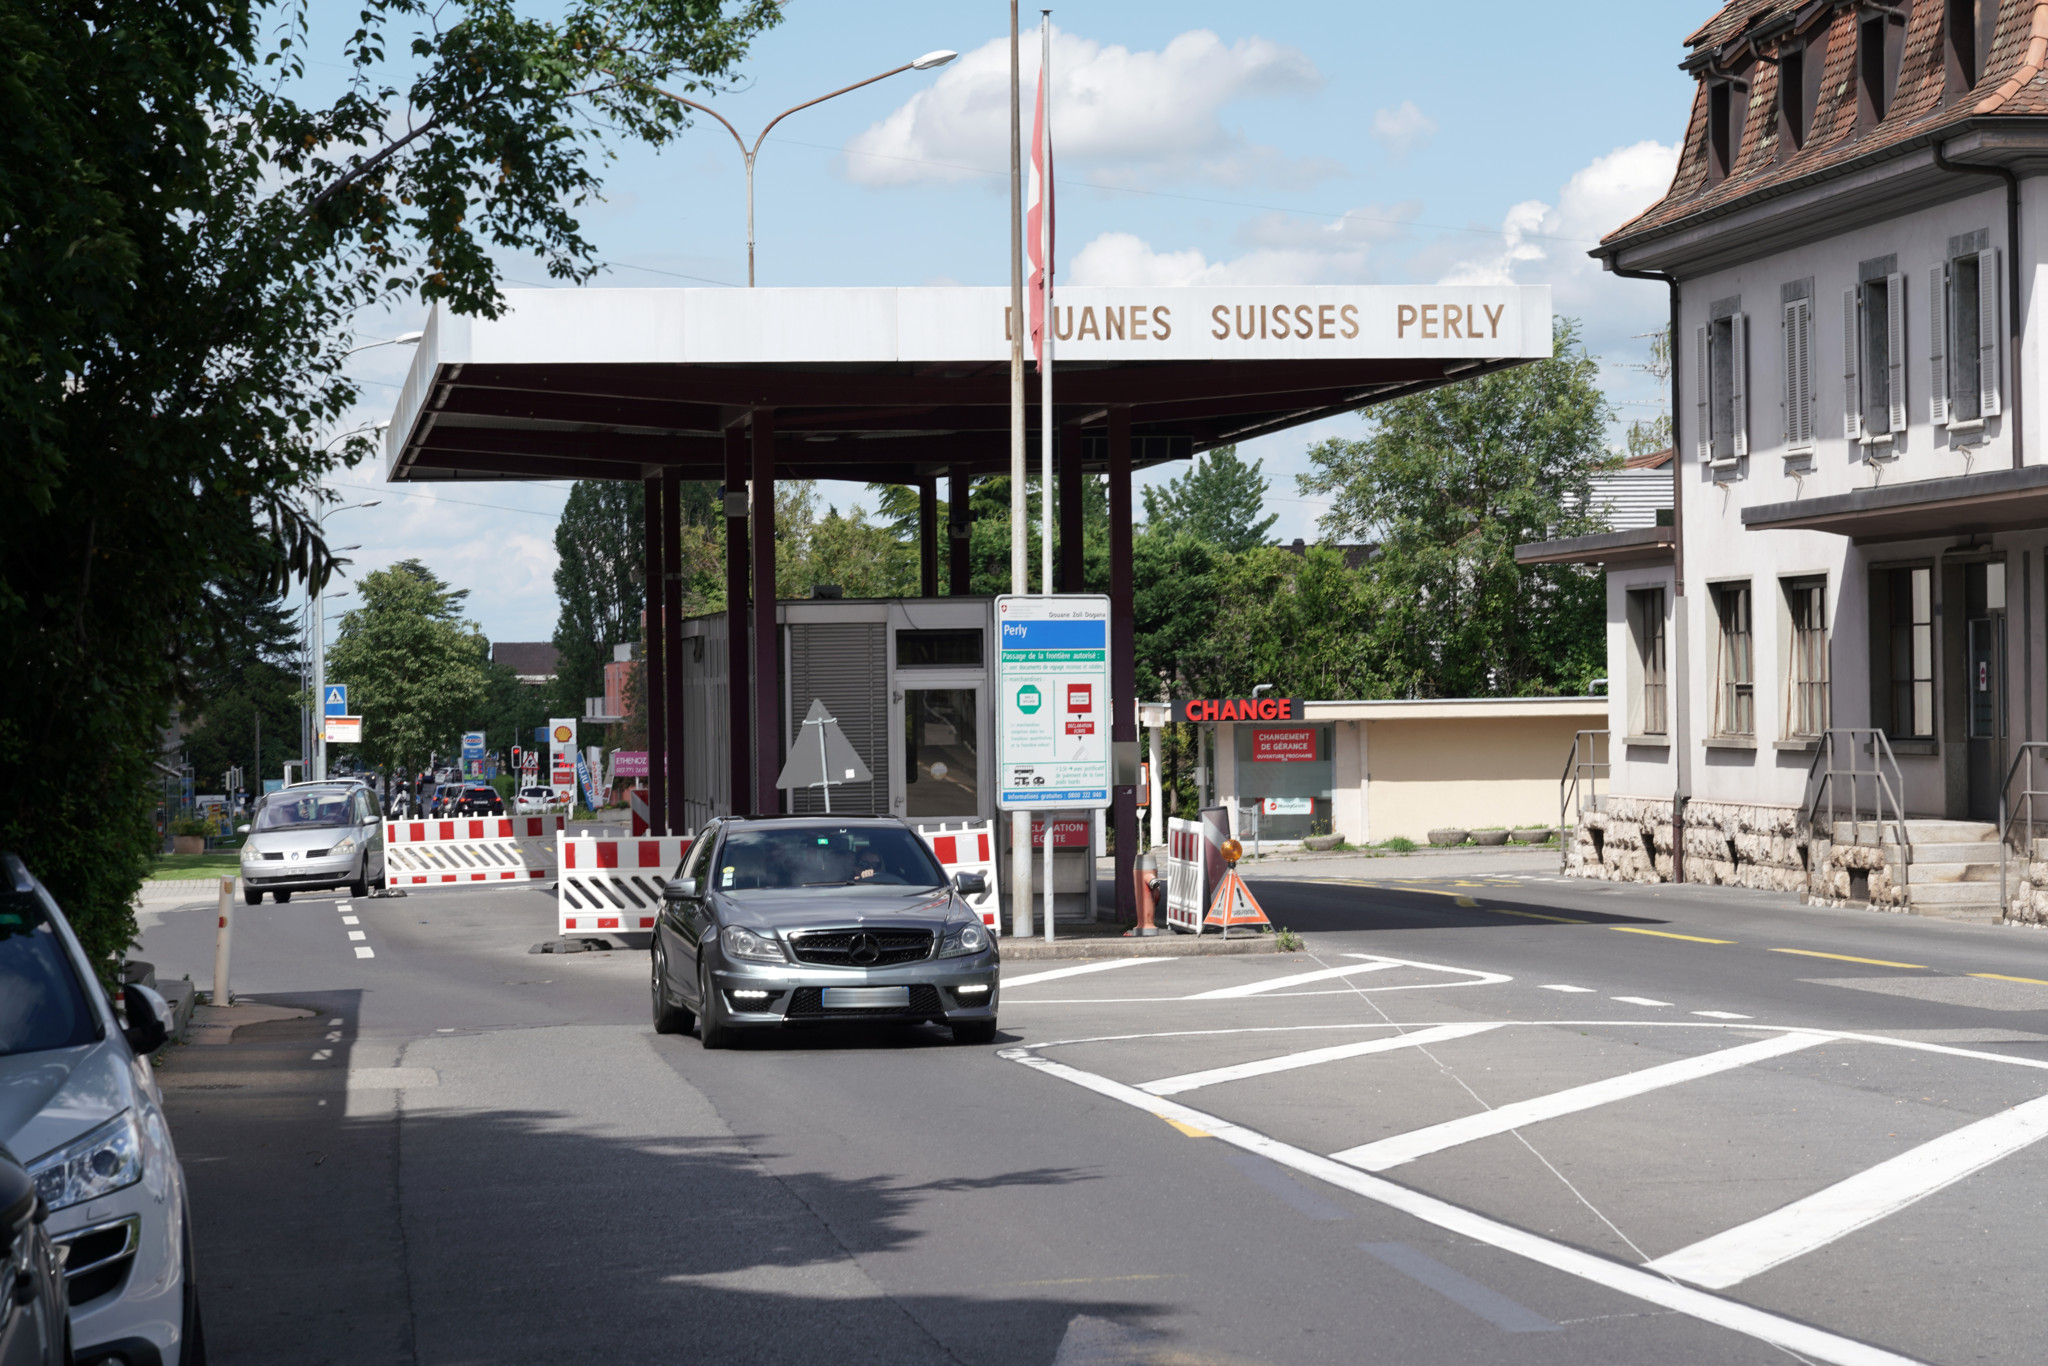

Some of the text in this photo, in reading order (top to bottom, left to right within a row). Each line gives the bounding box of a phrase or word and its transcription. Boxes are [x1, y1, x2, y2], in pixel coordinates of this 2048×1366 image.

[1005, 304, 1505, 341] UANES SUISSES PERLY
[1085, 611, 1106, 619] Dogana
[1004, 624, 1028, 639] Perly
[1002, 652, 1026, 662] Passage
[1028, 652, 1036, 660] de
[1038, 652, 1044, 660] la
[1046, 651, 1071, 660] frontière
[1073, 651, 1096, 660] autorisé
[1186, 699, 1290, 721] CHANGE
[1258, 733, 1309, 741] CHANGEMENT
[1273, 741, 1308, 750] GÉRANCE
[1041, 793, 1063, 801] gratuites
